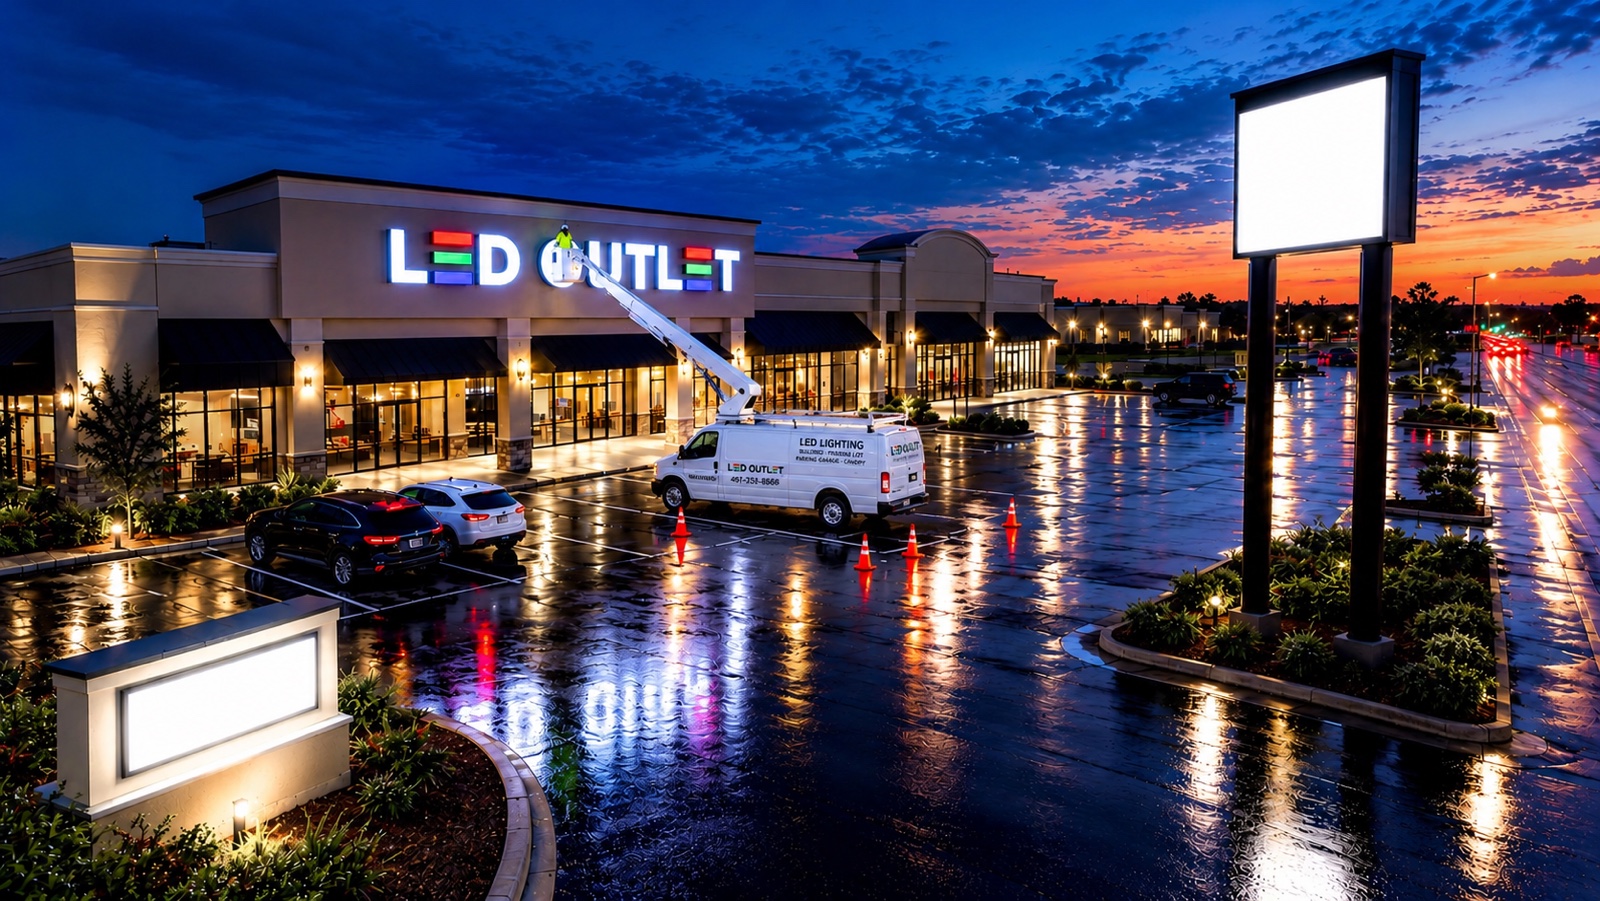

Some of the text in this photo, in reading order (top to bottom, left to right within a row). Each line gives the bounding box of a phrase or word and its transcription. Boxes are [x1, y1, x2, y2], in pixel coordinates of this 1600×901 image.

[387, 228, 521, 286] LED
[799, 437, 864, 450] LED LIGHTING
[727, 463, 784, 474] LED OUTLET
